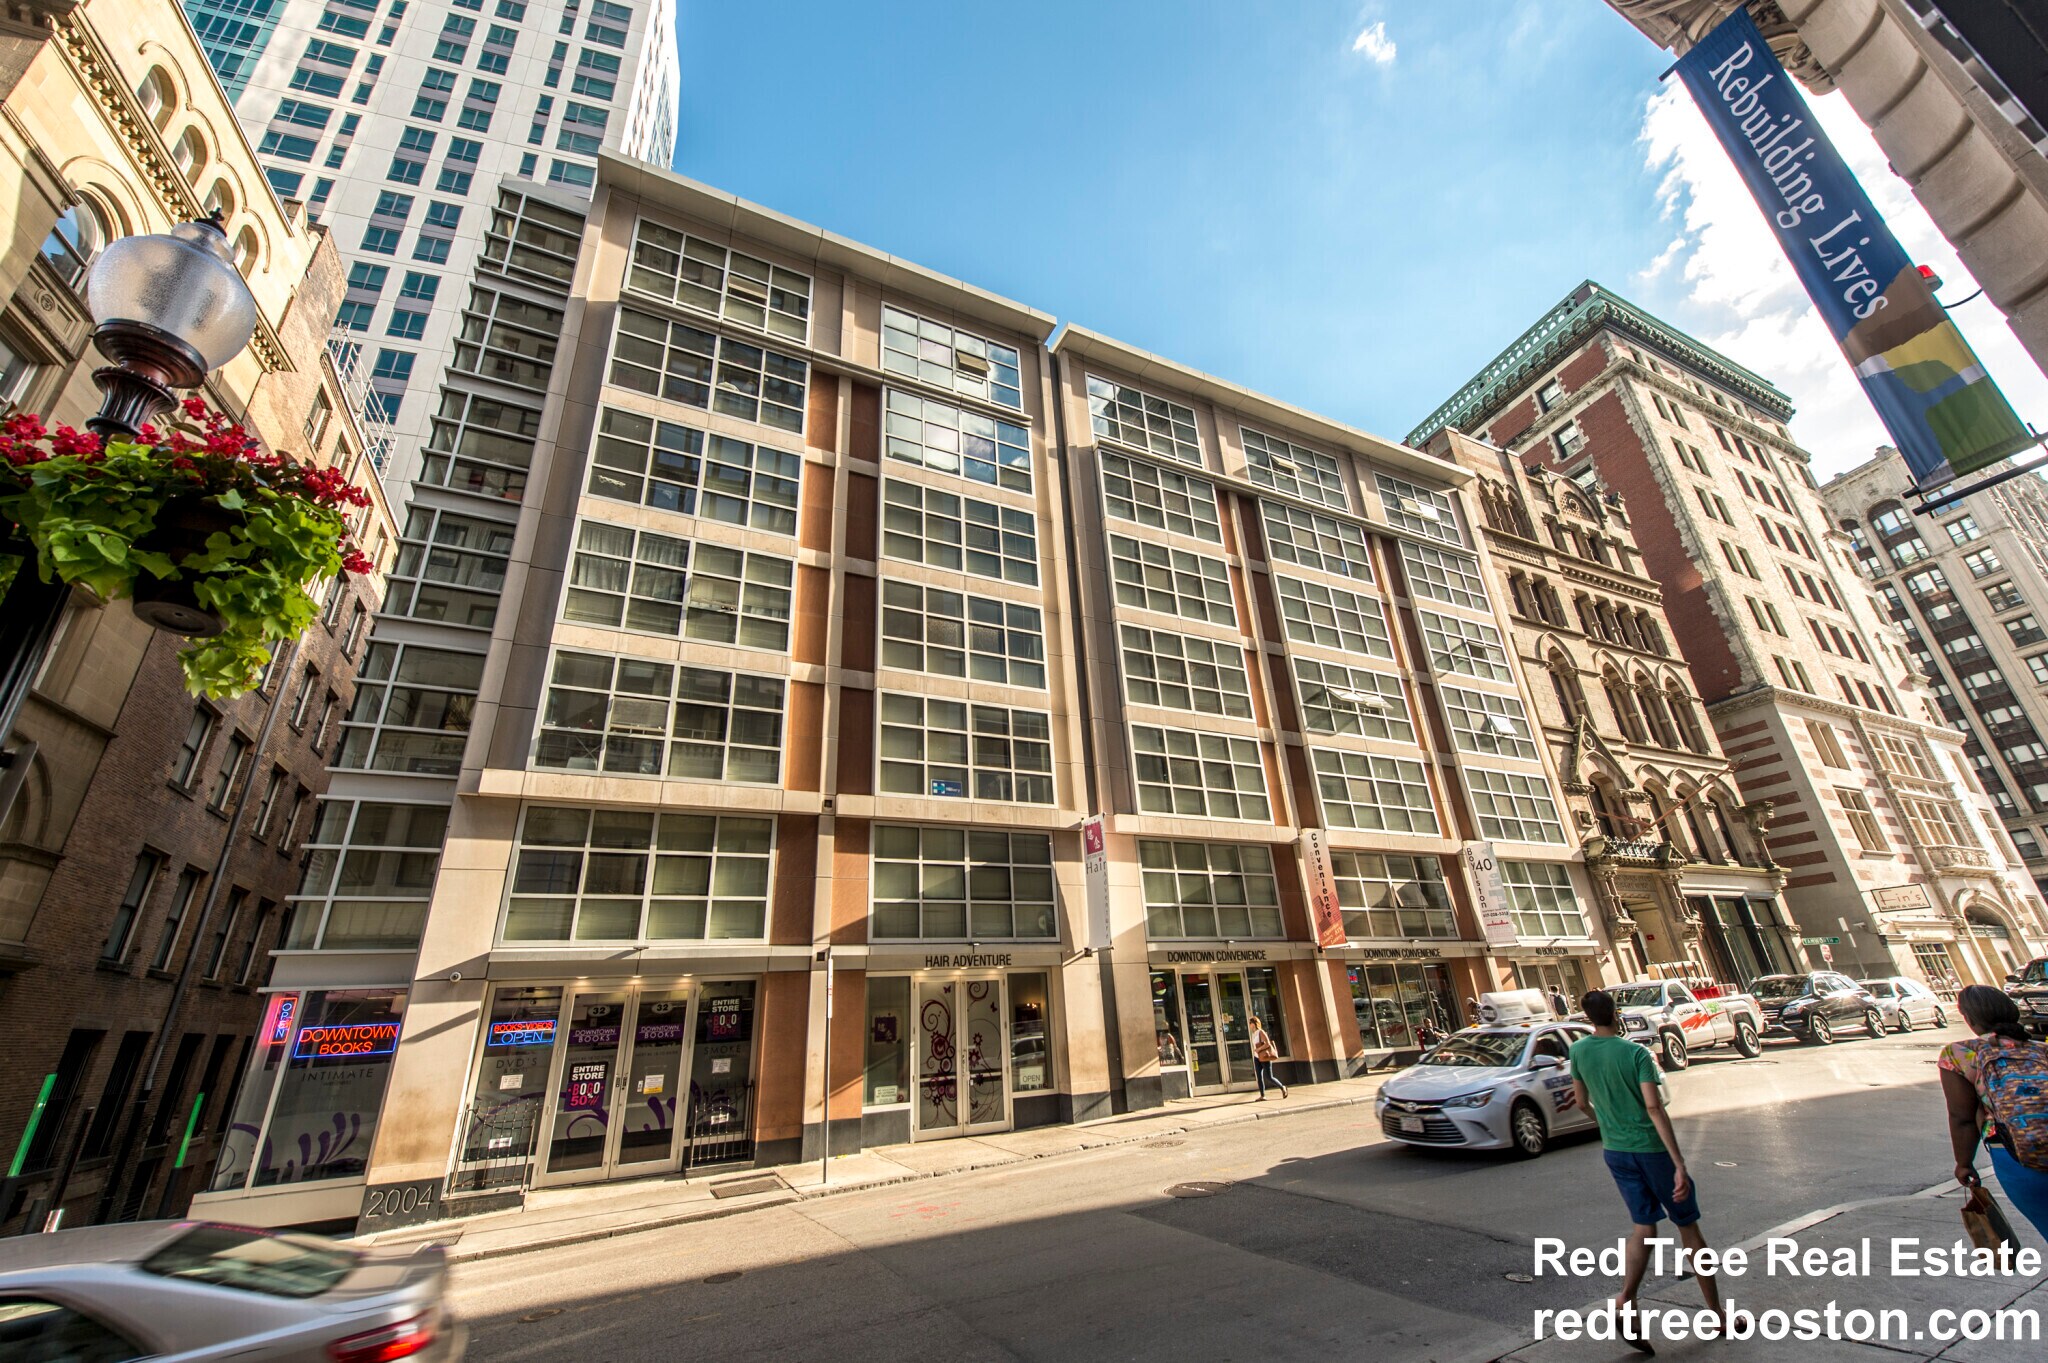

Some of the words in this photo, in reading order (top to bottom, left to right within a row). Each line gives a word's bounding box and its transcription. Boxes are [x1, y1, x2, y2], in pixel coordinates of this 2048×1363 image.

[1708, 40, 1825, 229] Rebuilding
[1809, 209, 1889, 320] Lives
[1086, 857, 1106, 874] Hair
[1476, 858, 1492, 871] 40
[1311, 833, 1332, 918] Convenience
[1466, 847, 1487, 908] Boylston
[1878, 889, 1922, 905] Fin's
[1167, 951, 1215, 962] DOWNTOWN
[1216, 950, 1267, 961] CONVENIENCE
[1363, 948, 1401, 958] DOWNTOWN
[1401, 948, 1442, 958] CONVENIENCE
[925, 954, 950, 968] HAIR
[952, 953, 1012, 967] ADVENTURE
[656, 1003, 669, 1012] 32
[712, 998, 740, 1006] ENTIRE
[592, 1006, 606, 1015] 32
[711, 1005, 740, 1013] STORE
[275, 1002, 293, 1039] OPEN
[299, 1025, 398, 1043] DOWNTOWN
[575, 1028, 616, 1036] DOWNTOWN
[641, 1025, 680, 1033] DOWNTOWN
[644, 1031, 674, 1039] BOOKS
[501, 1030, 544, 1044] OPEN
[578, 1035, 610, 1043] BOOKS
[319, 1041, 373, 1054] BOOKS
[496, 1057, 537, 1069] DVD'S
[573, 1064, 606, 1074] ENTIRE
[302, 1067, 375, 1082] INTIMATE
[571, 1072, 605, 1081] STORE
[1022, 1074, 1041, 1083] OPEN
[572, 1081, 601, 1096] BOGO
[366, 1184, 435, 1218] 2004
